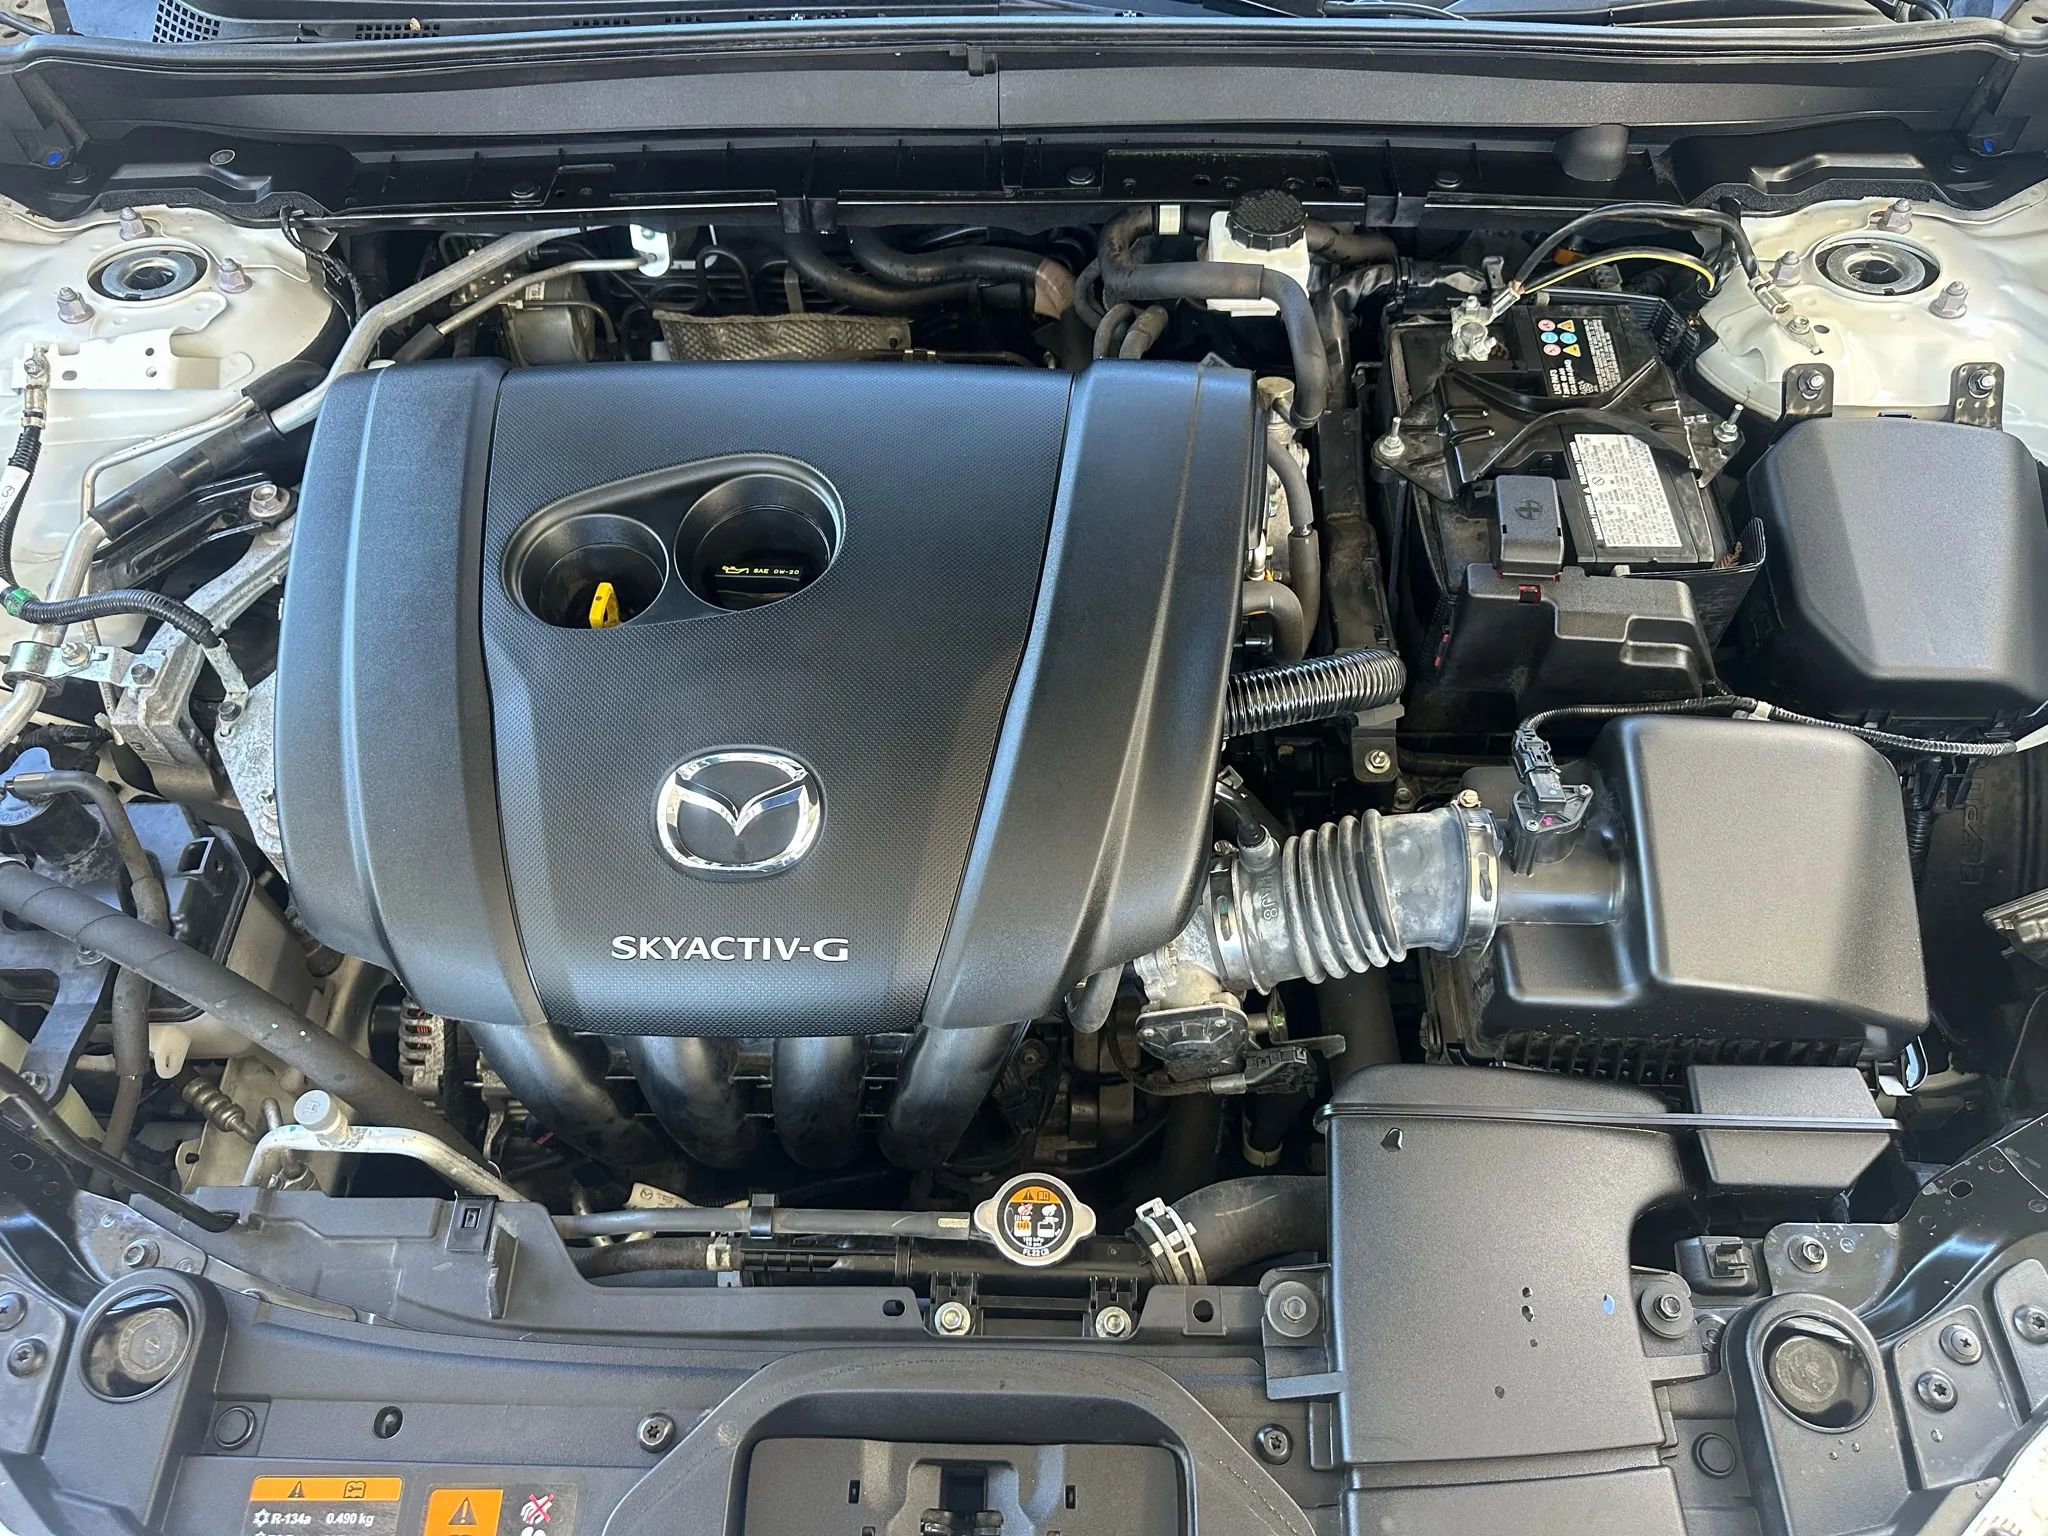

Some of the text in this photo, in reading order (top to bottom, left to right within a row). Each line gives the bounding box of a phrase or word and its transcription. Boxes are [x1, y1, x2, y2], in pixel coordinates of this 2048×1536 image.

[611, 935, 849, 962] SKYACTIV-G
[270, 1512, 375, 1527] R-134a 0.490 kg
